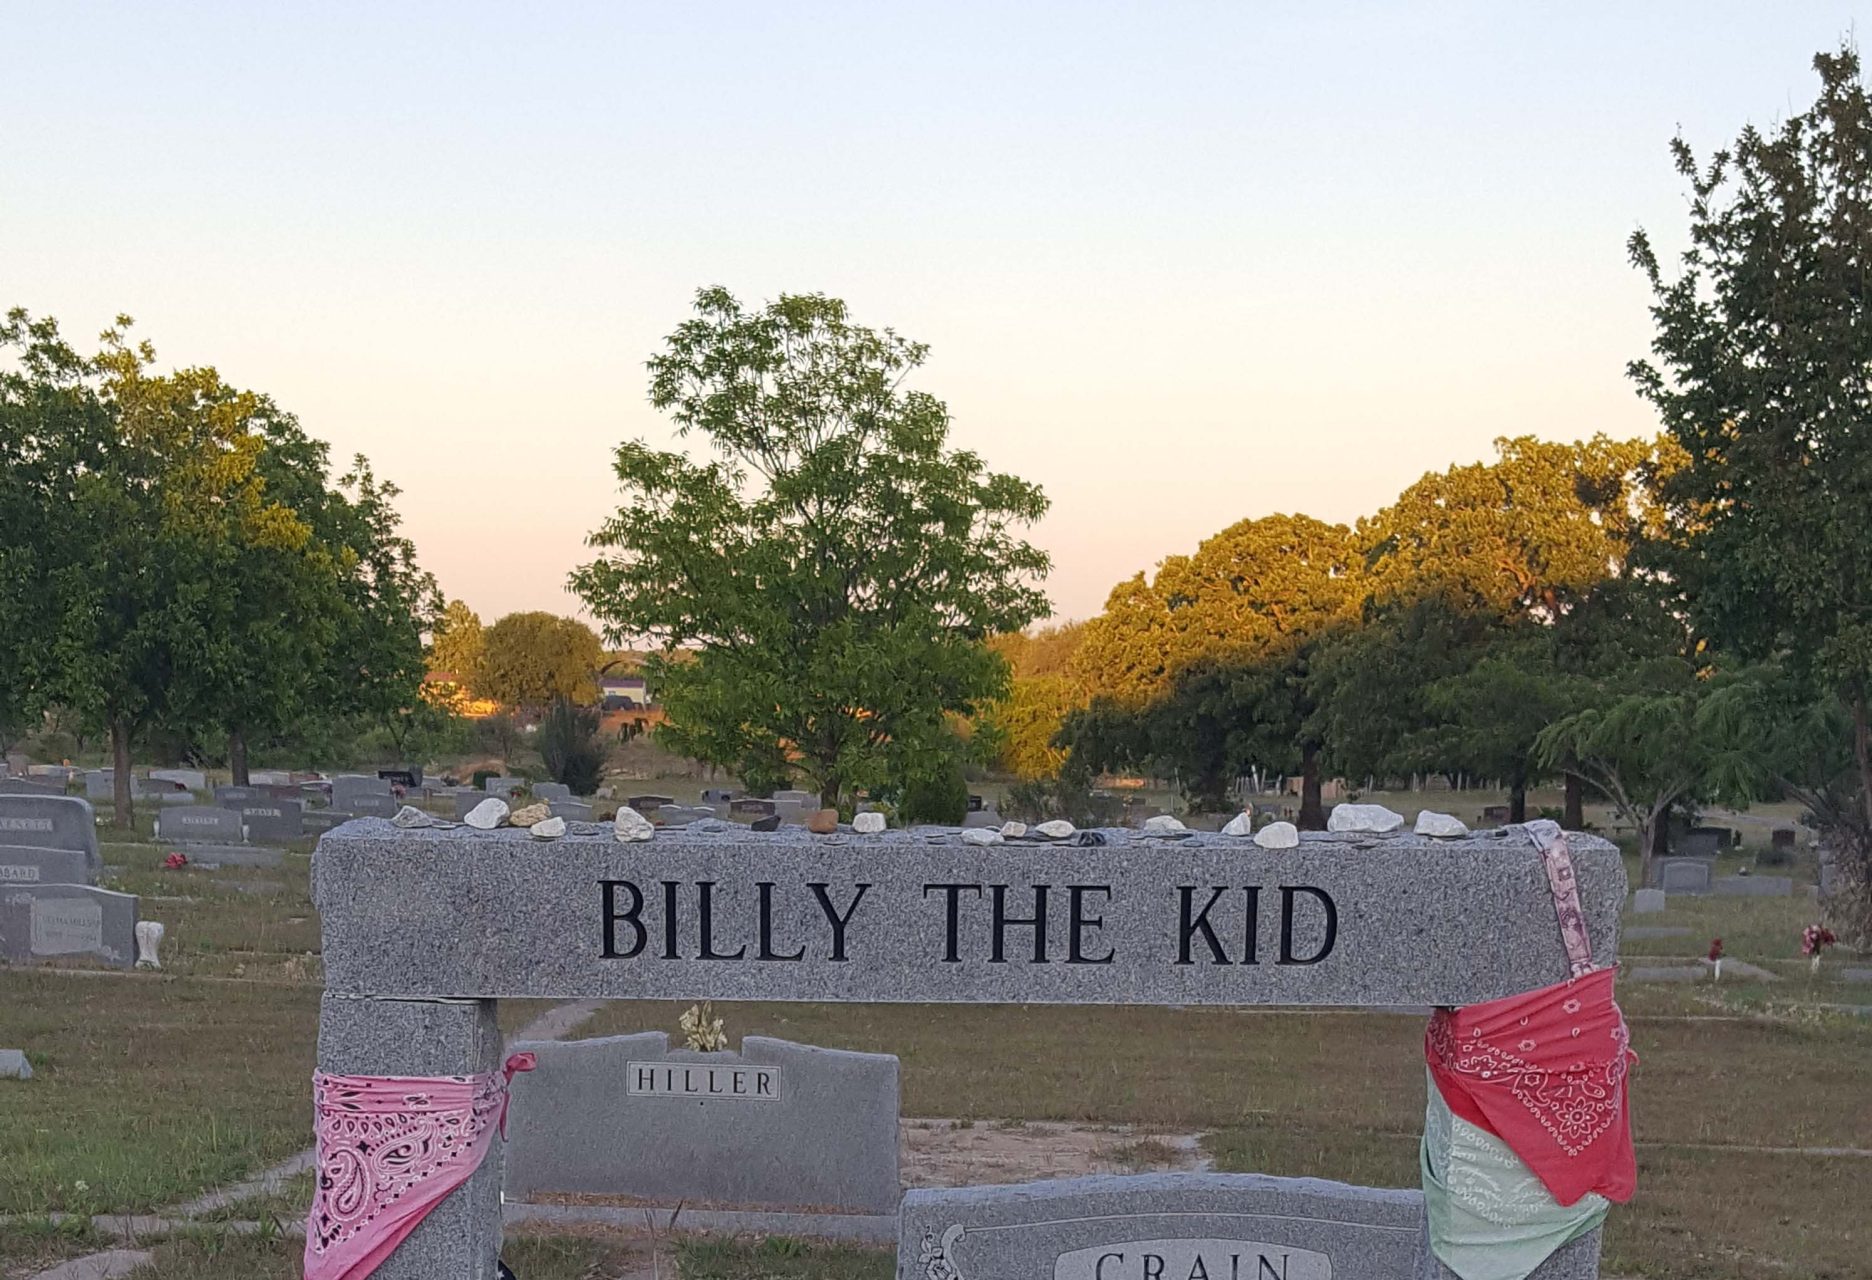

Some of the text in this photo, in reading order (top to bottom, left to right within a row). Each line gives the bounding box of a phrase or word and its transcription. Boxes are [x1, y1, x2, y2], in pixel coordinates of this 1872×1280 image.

[599, 879, 1340, 967] BILLY THE KID
[638, 1069, 771, 1095] HILLER
